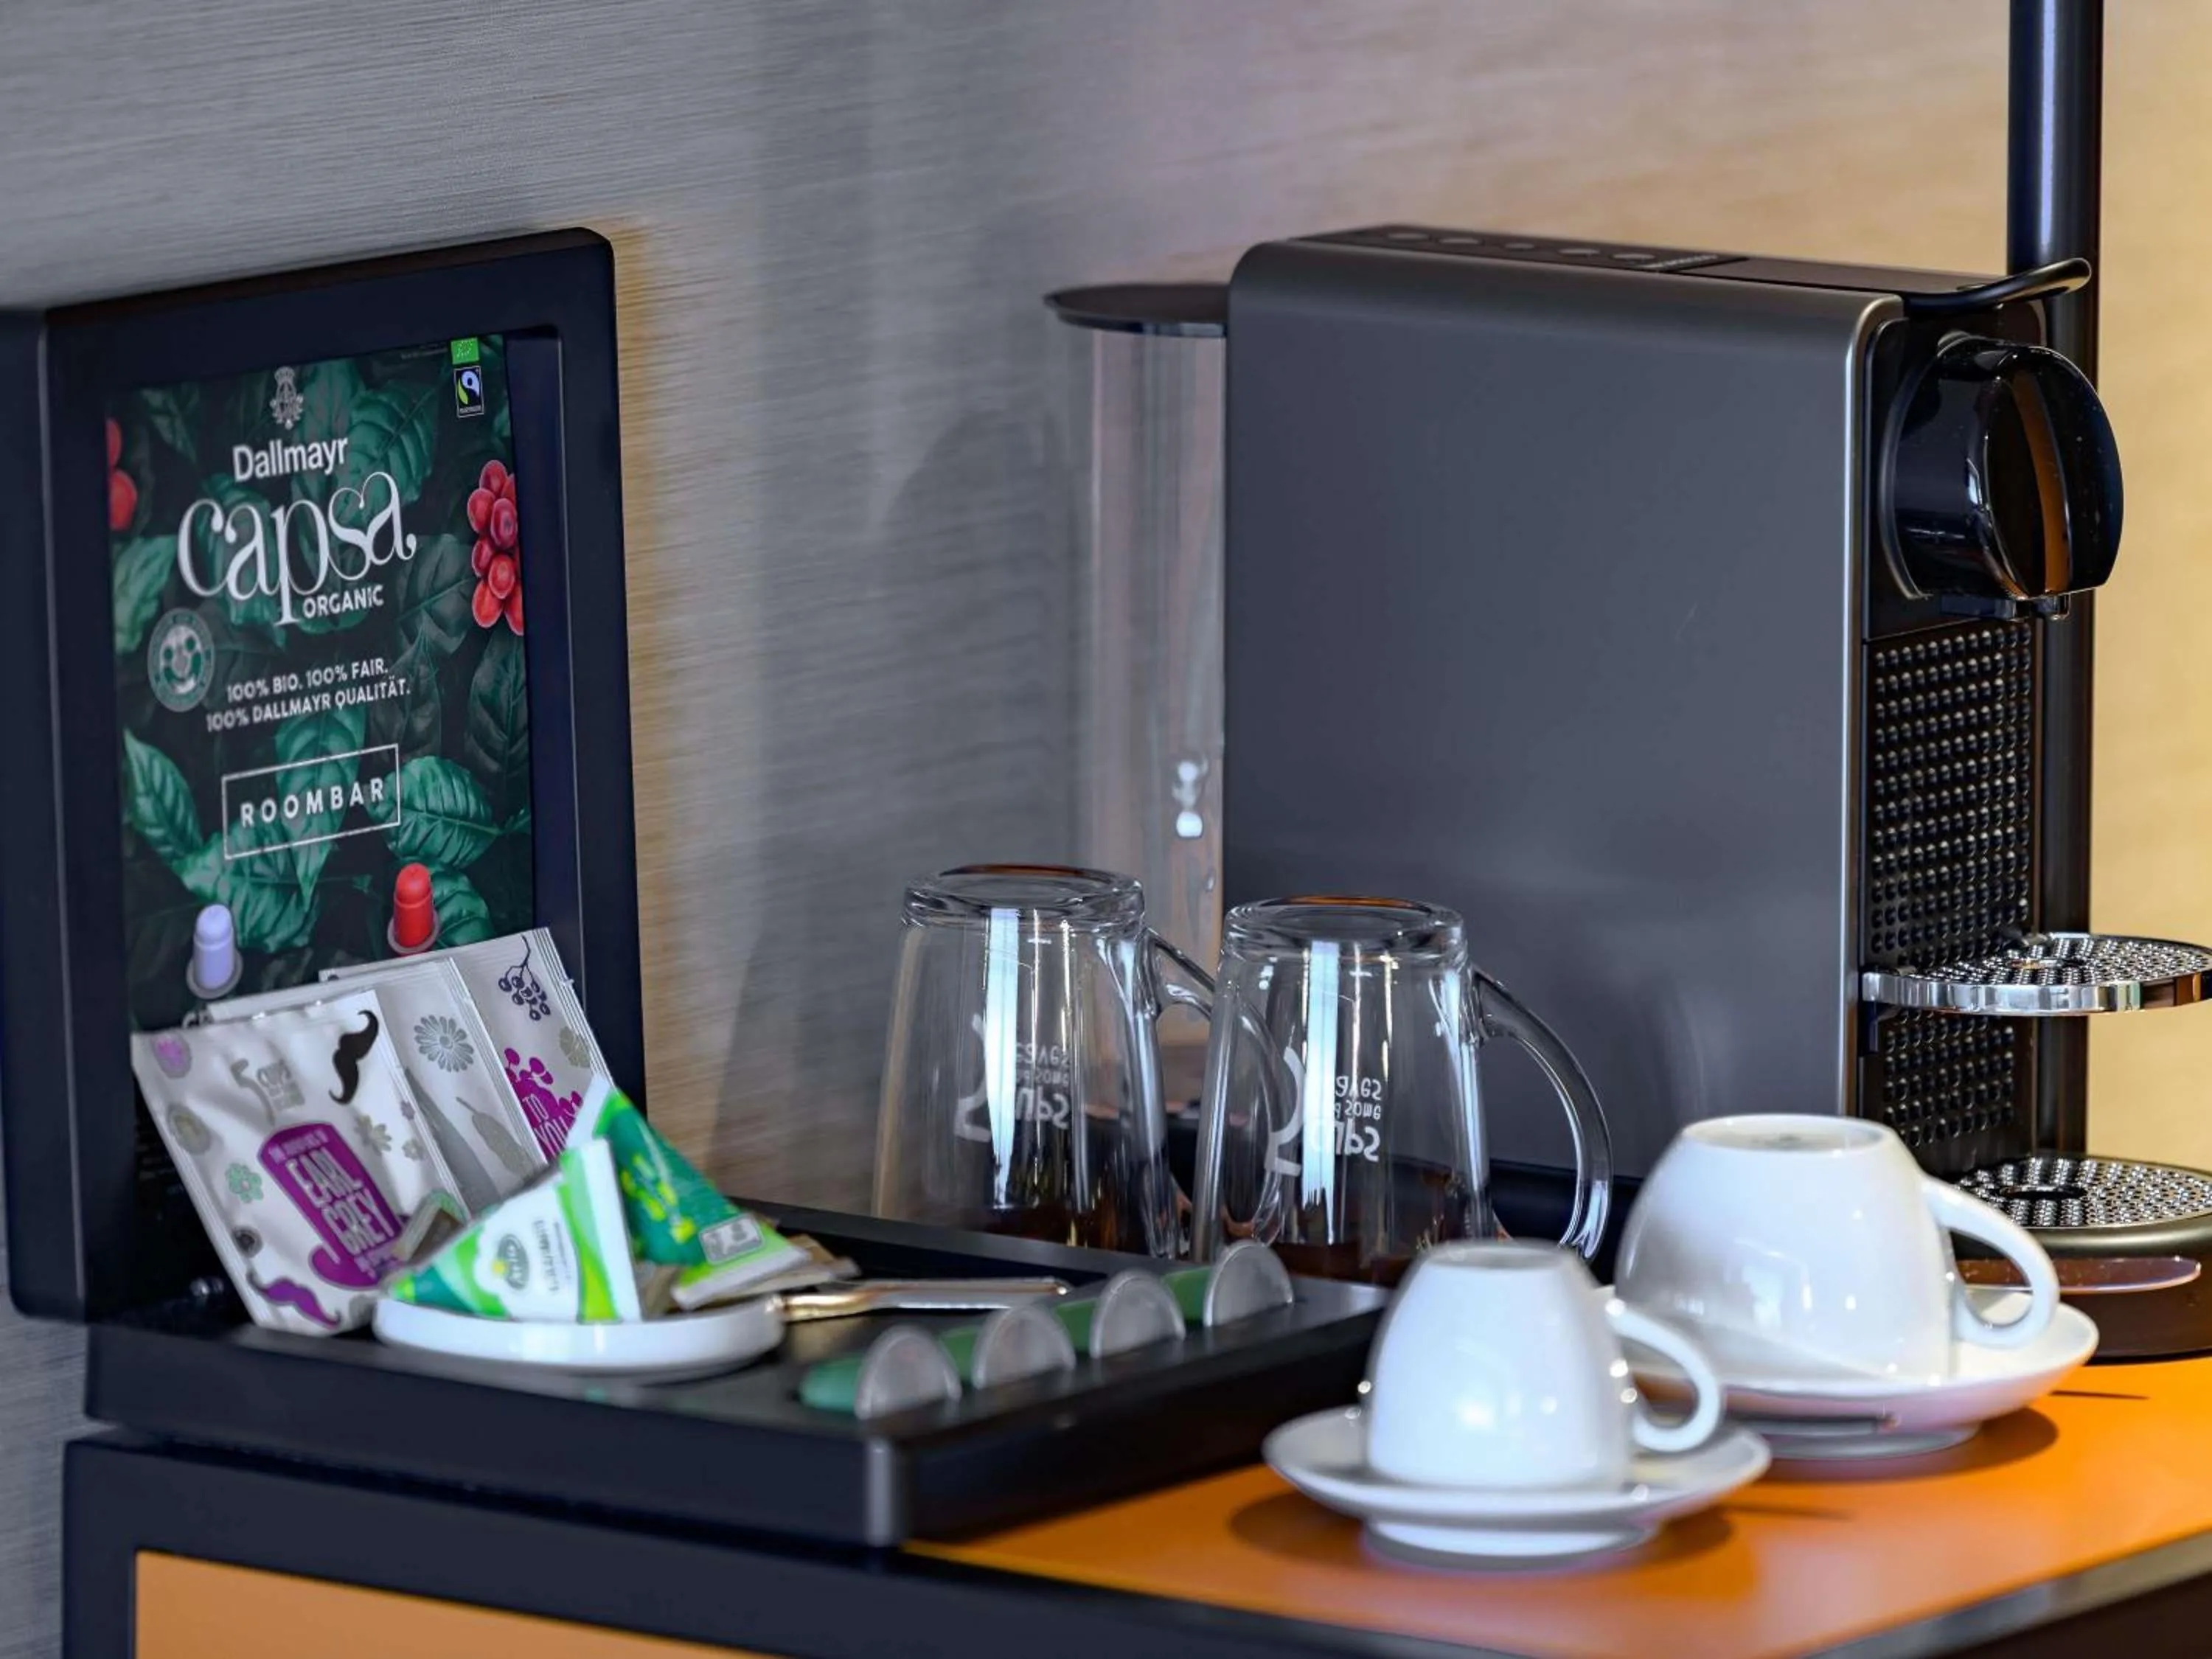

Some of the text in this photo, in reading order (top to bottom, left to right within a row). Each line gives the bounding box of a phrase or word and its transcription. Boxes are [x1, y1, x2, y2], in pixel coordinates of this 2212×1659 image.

[233, 437, 349, 482] Dallmayr
[177, 471, 417, 626] capsa
[302, 585, 384, 619] ORGANIC
[206, 675, 411, 732] 100% DALLMAYR QUALITÄT.
[226, 657, 389, 703] 100% BIO. 100% FAIR.
[240, 777, 385, 829] ROOMBAR
[285, 1145, 364, 1209] EARL
[321, 1186, 395, 1258] GREY
